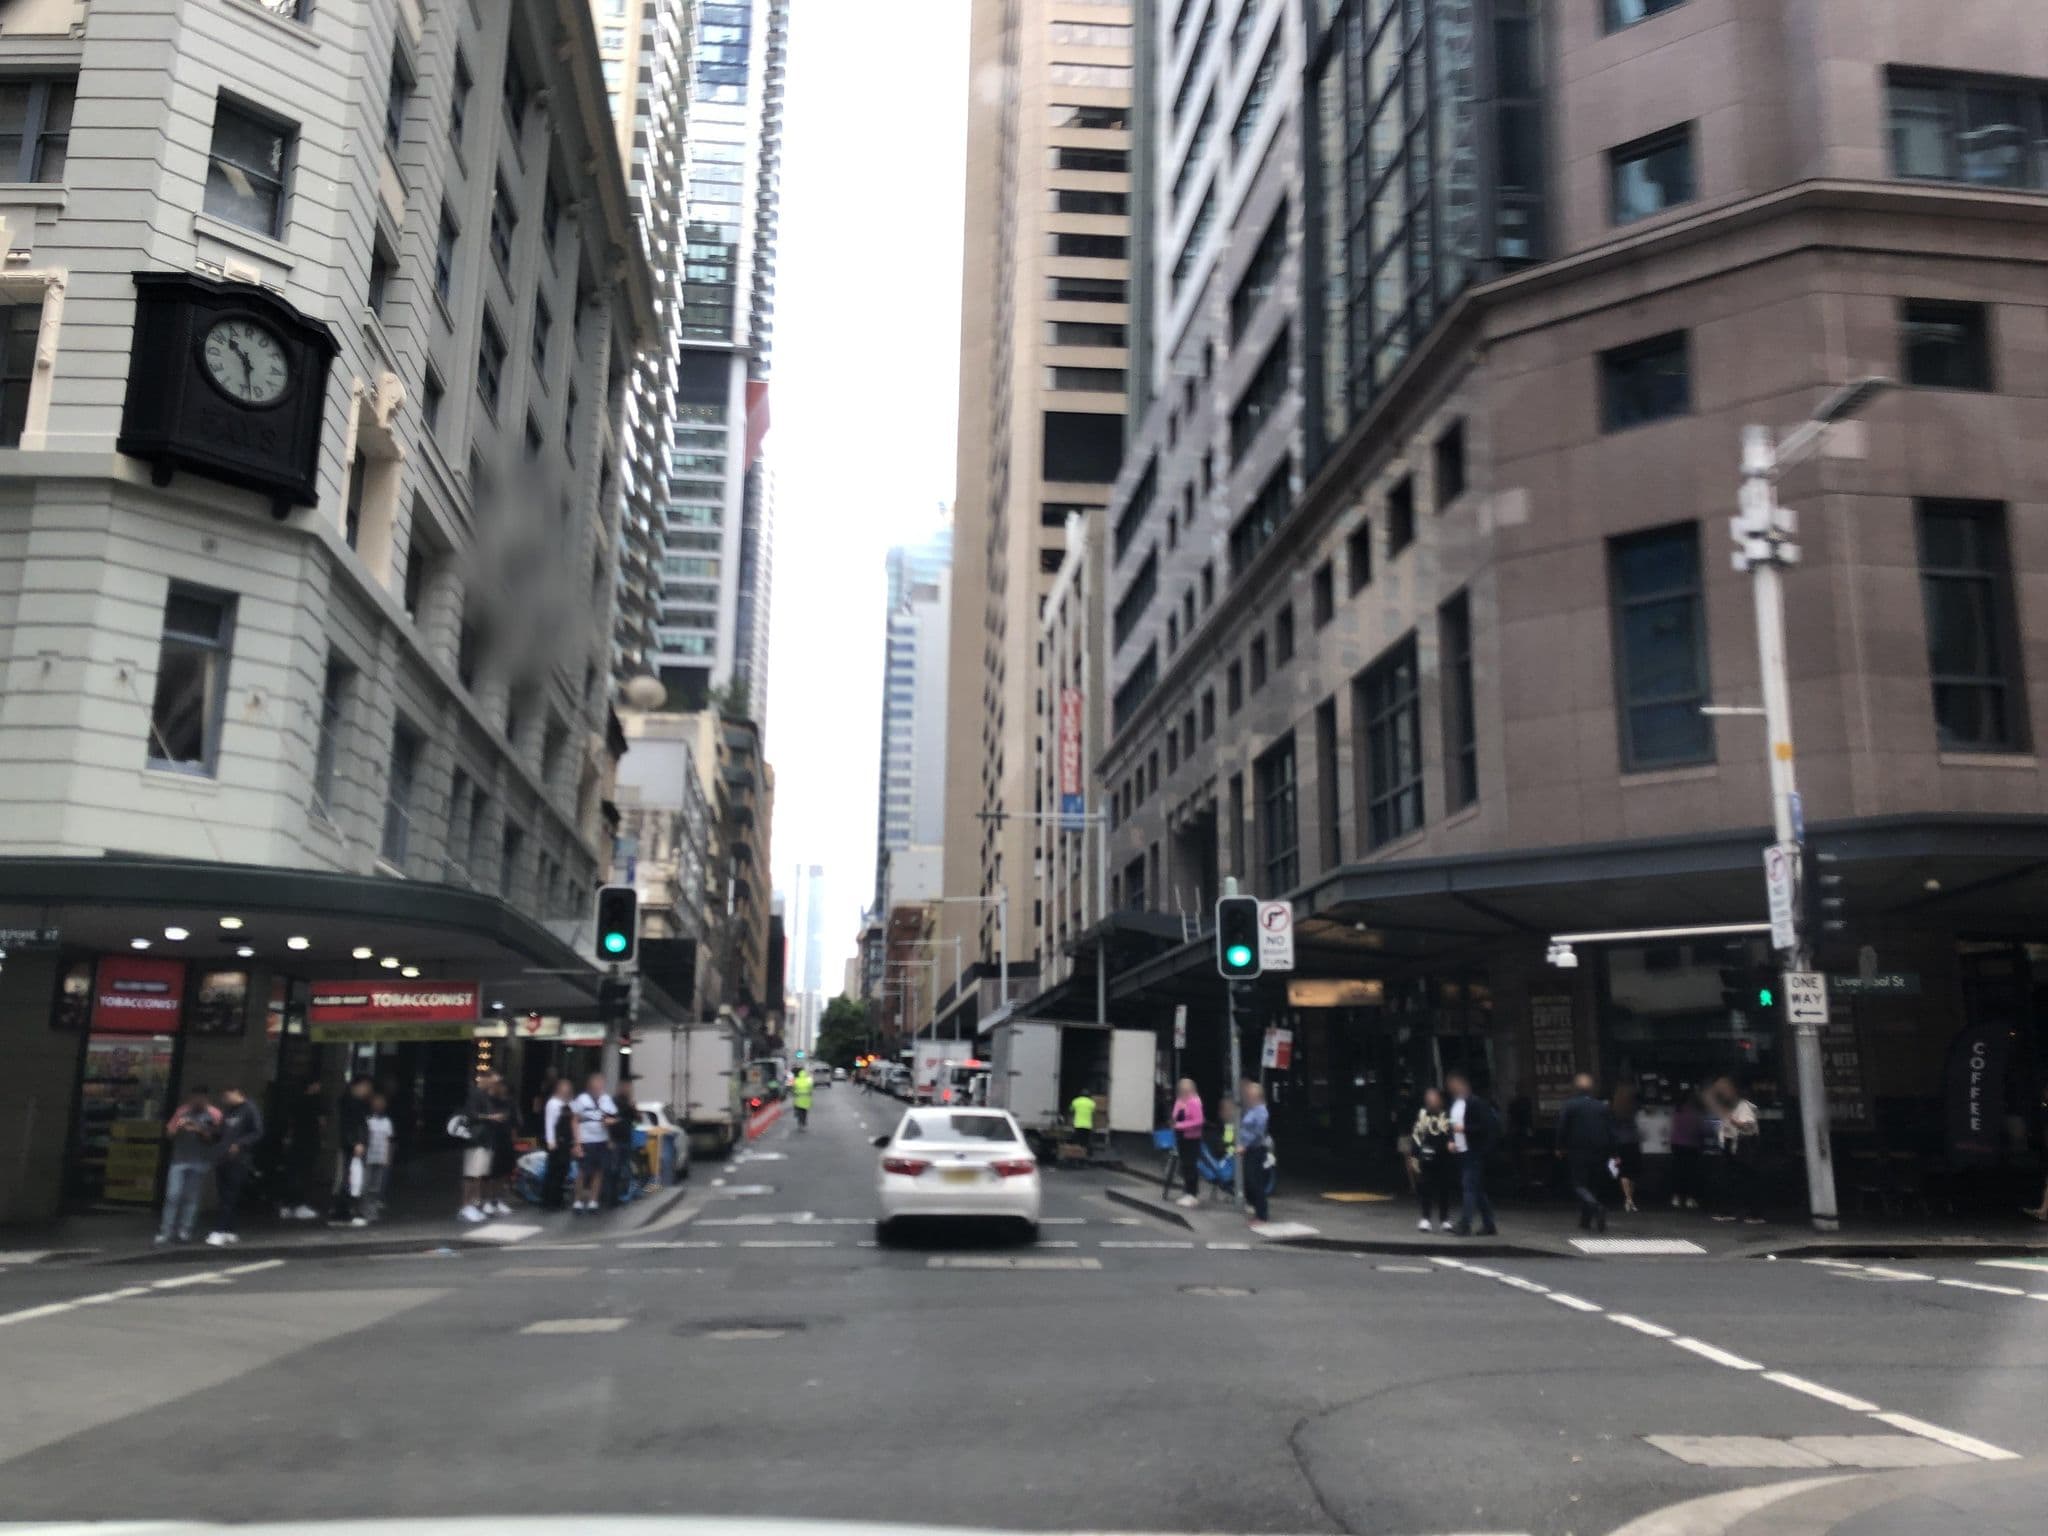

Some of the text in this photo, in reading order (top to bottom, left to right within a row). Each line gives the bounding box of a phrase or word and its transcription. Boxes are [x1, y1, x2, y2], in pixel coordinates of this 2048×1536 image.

[1791, 976, 1818, 989] ONE
[1833, 975, 1905, 988] Liverool St
[99, 995, 178, 1009] TOBACCONIST
[371, 992, 473, 1007] TOBACCONIST
[1791, 993, 1822, 1005] WAY
[1969, 1042, 1986, 1131] COFFEE
